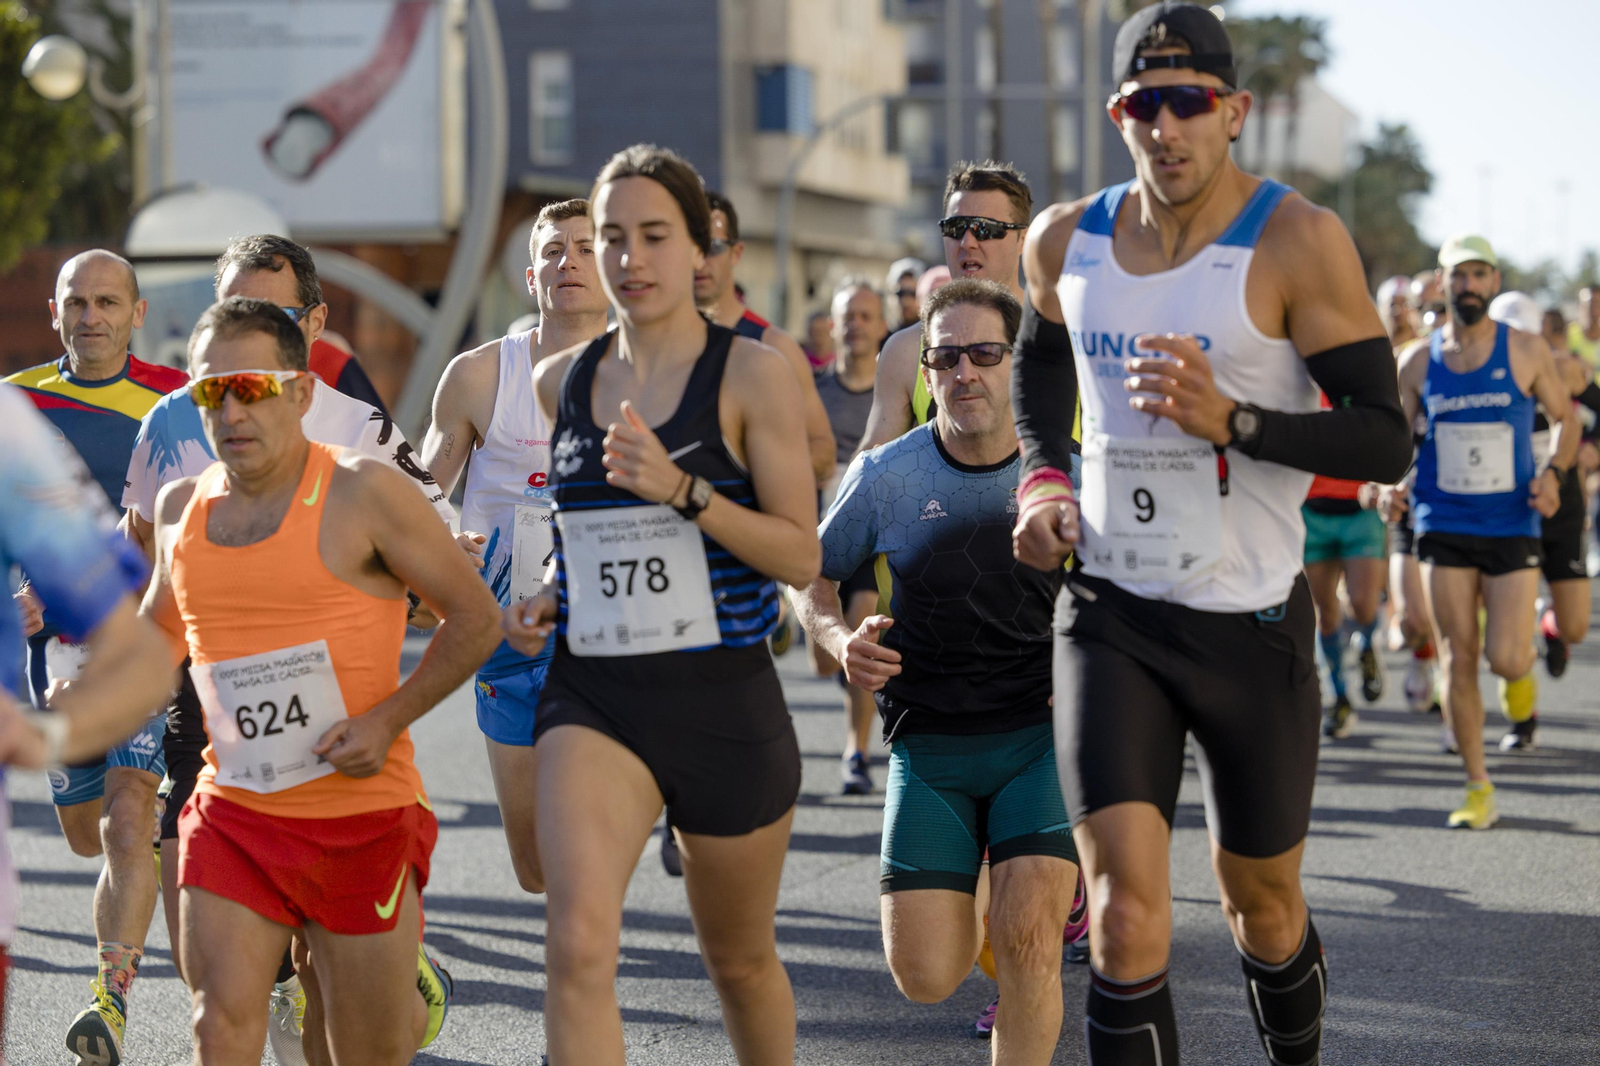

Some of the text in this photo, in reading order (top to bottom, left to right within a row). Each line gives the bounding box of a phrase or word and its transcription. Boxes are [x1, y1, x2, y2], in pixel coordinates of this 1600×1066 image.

[1468, 447, 1481, 466] 5
[1133, 487, 1155, 523] 9
[600, 557, 670, 598] 578
[263, 674, 276, 684] DE
[235, 694, 309, 740] 624
